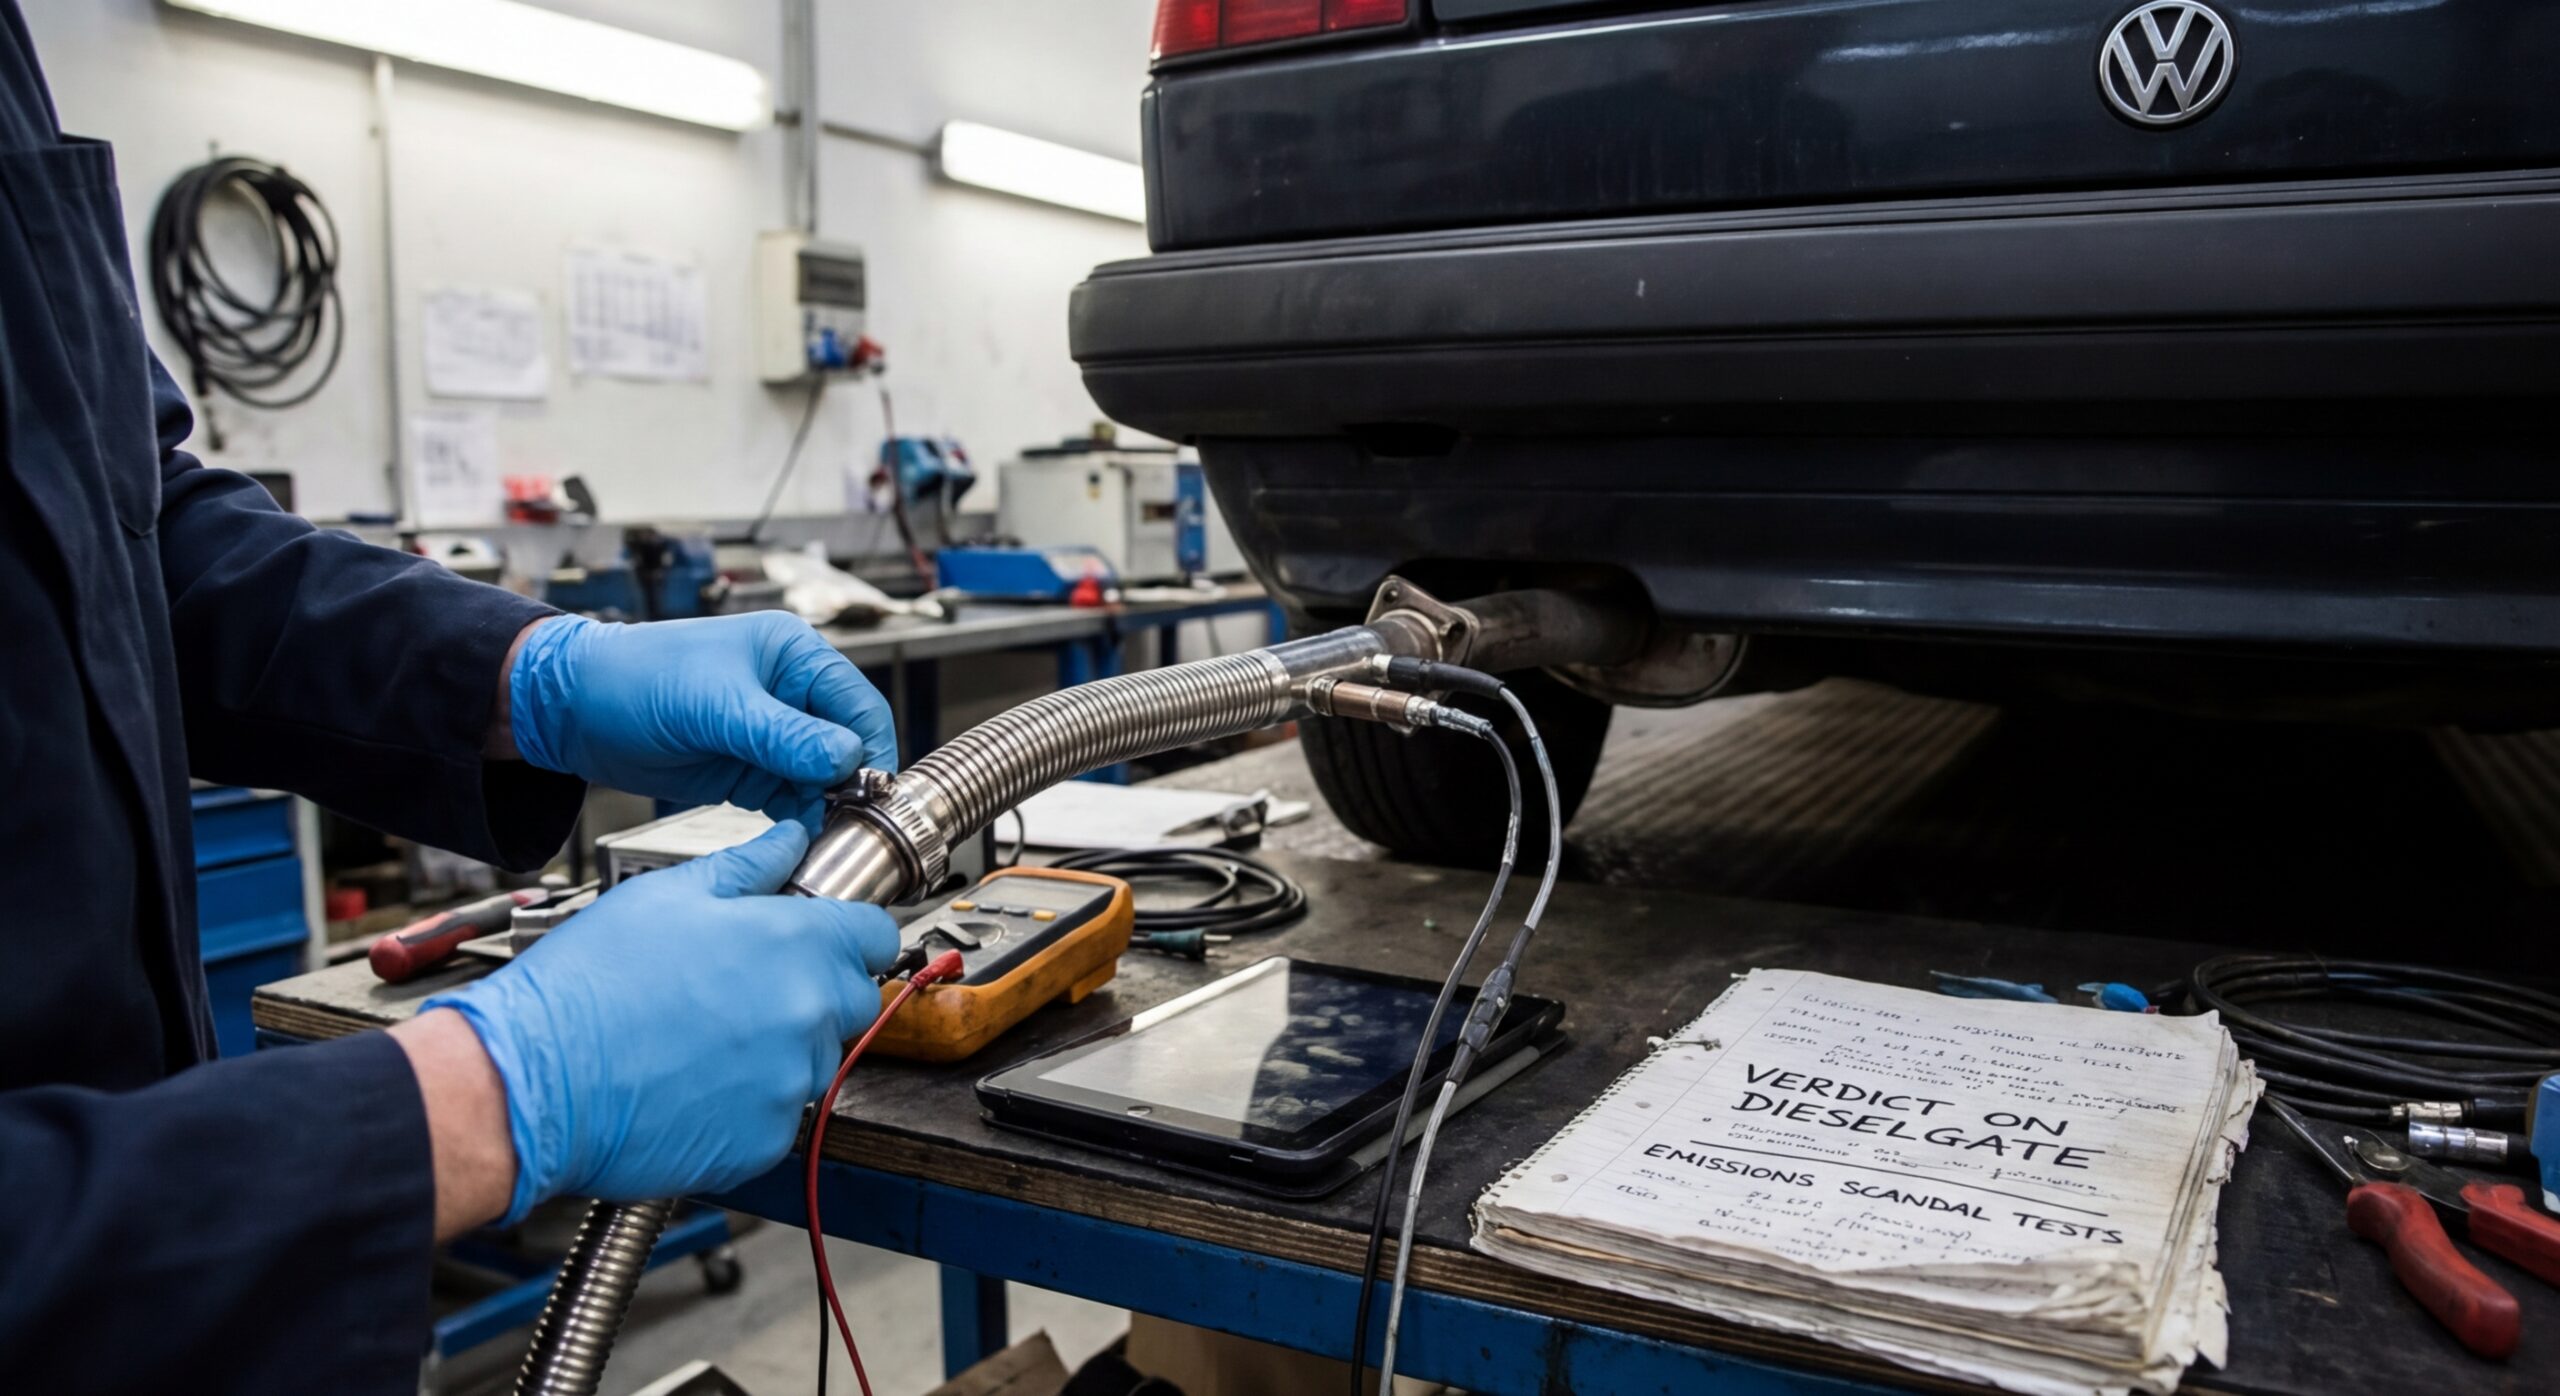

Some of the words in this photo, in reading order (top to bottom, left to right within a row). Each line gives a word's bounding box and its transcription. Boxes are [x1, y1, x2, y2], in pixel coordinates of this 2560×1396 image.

[2106, 3, 2229, 118] VW
[1732, 1091, 2106, 1169] DIESELGATE
[1747, 1064, 1955, 1116] VERDICT
[1983, 1112, 2069, 1137] ON
[1643, 1144, 1815, 1187] EMISSIONS
[1840, 1181, 1991, 1222] SCANDAL
[2012, 1212, 2124, 1244] TESTS
